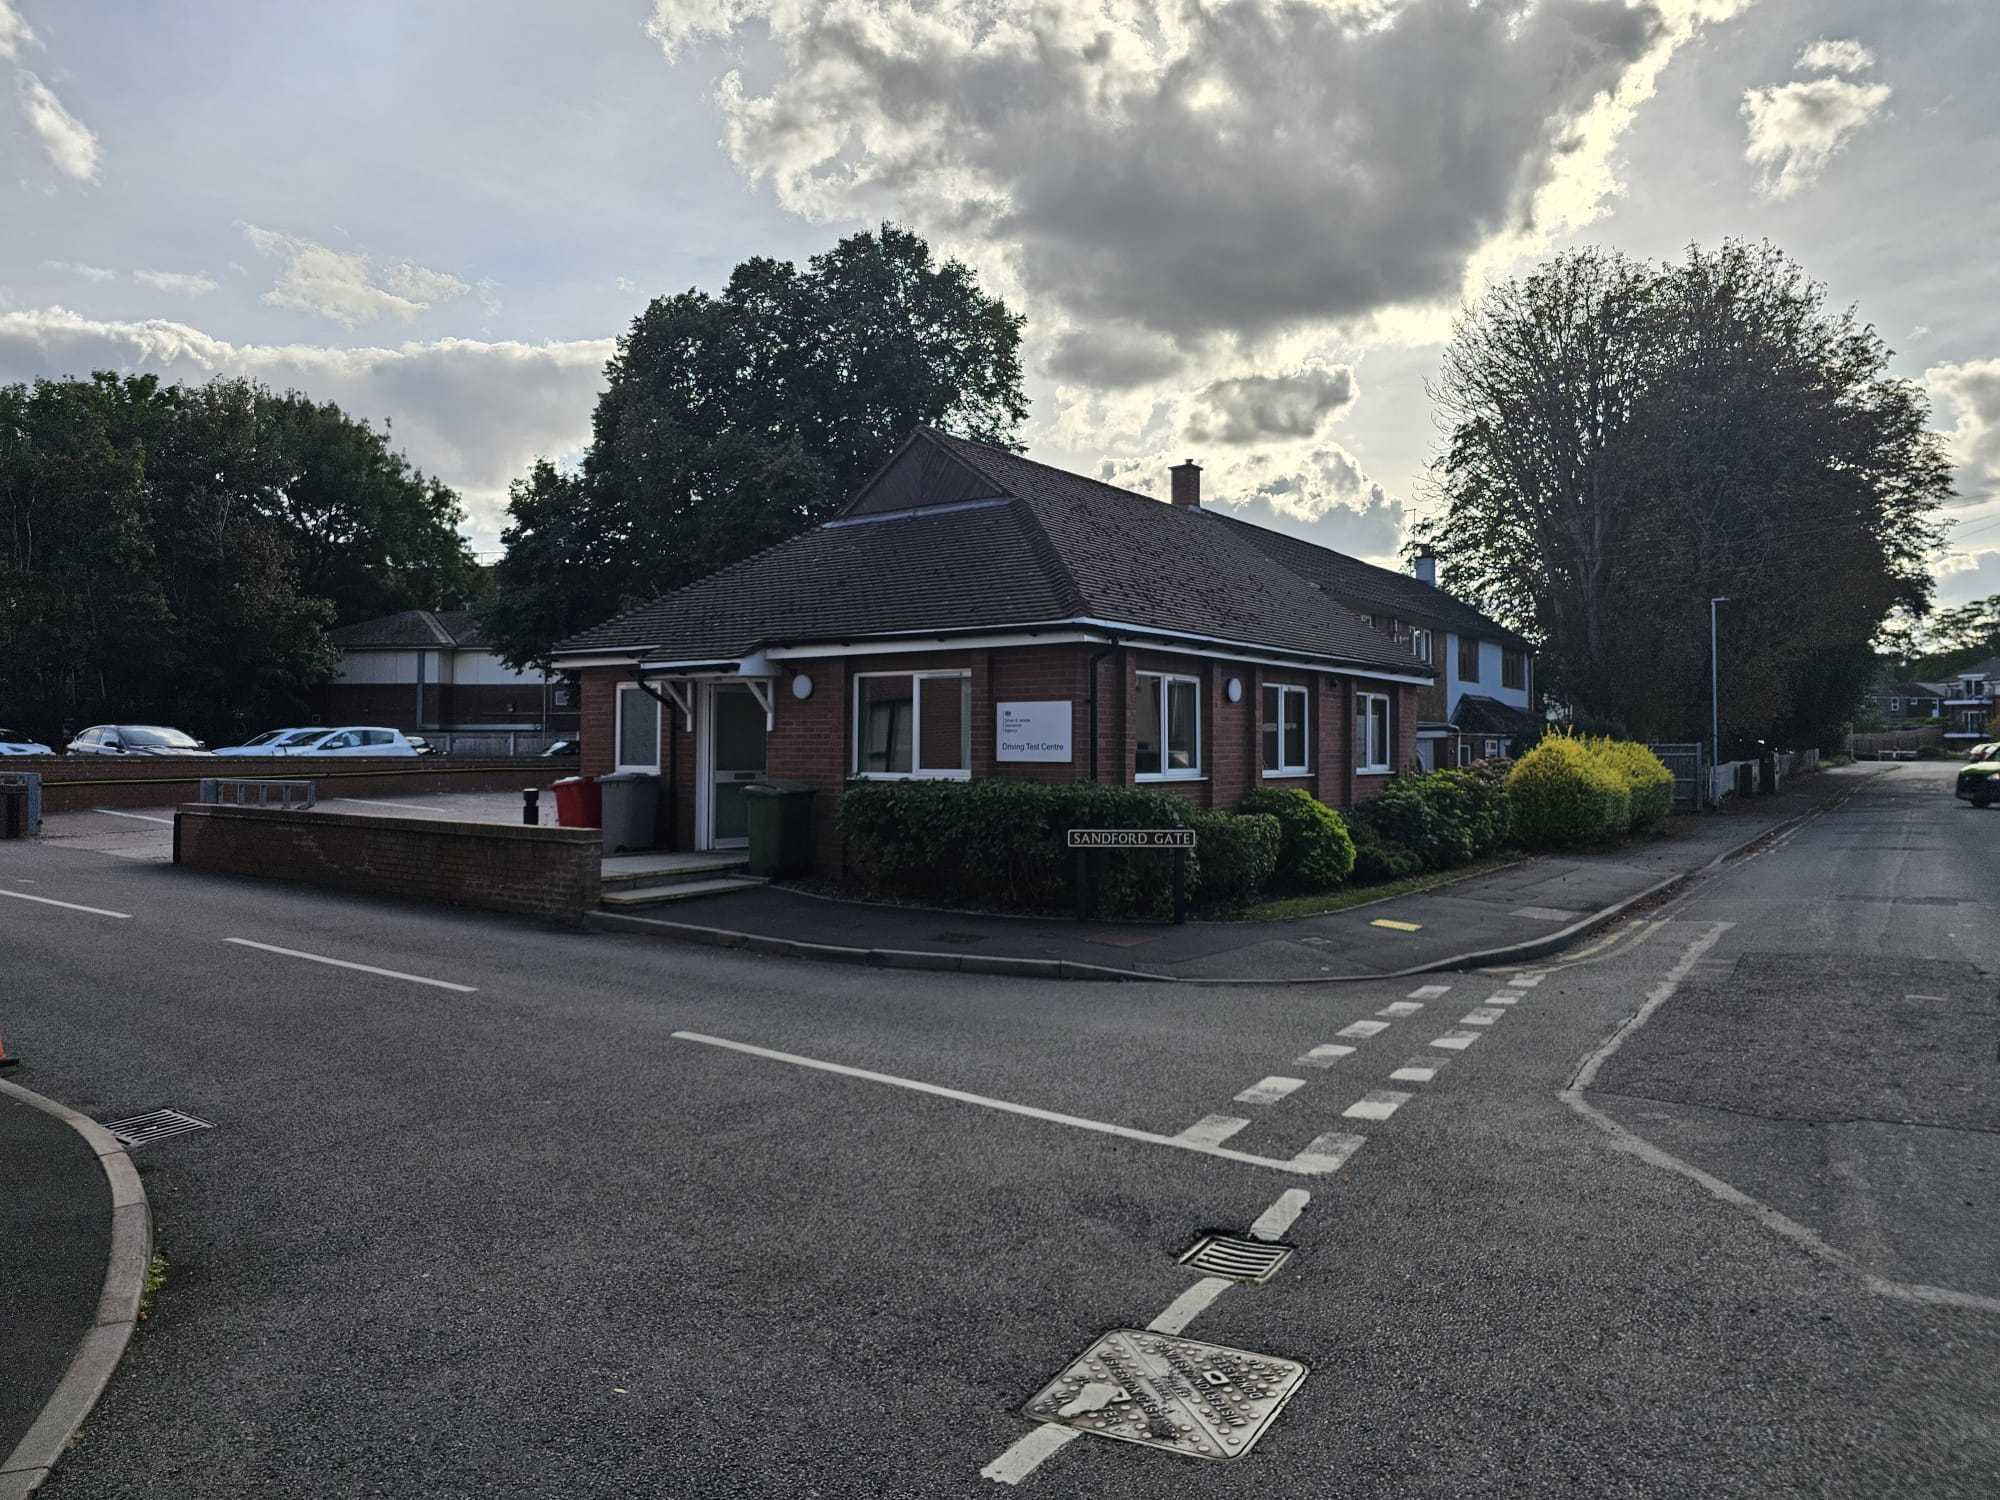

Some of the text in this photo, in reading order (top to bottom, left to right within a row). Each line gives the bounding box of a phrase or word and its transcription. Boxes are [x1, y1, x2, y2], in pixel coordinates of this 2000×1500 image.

[1002, 742, 1064, 752] Driving Test Centre
[1073, 832, 1191, 845] SANDFORD GATE
